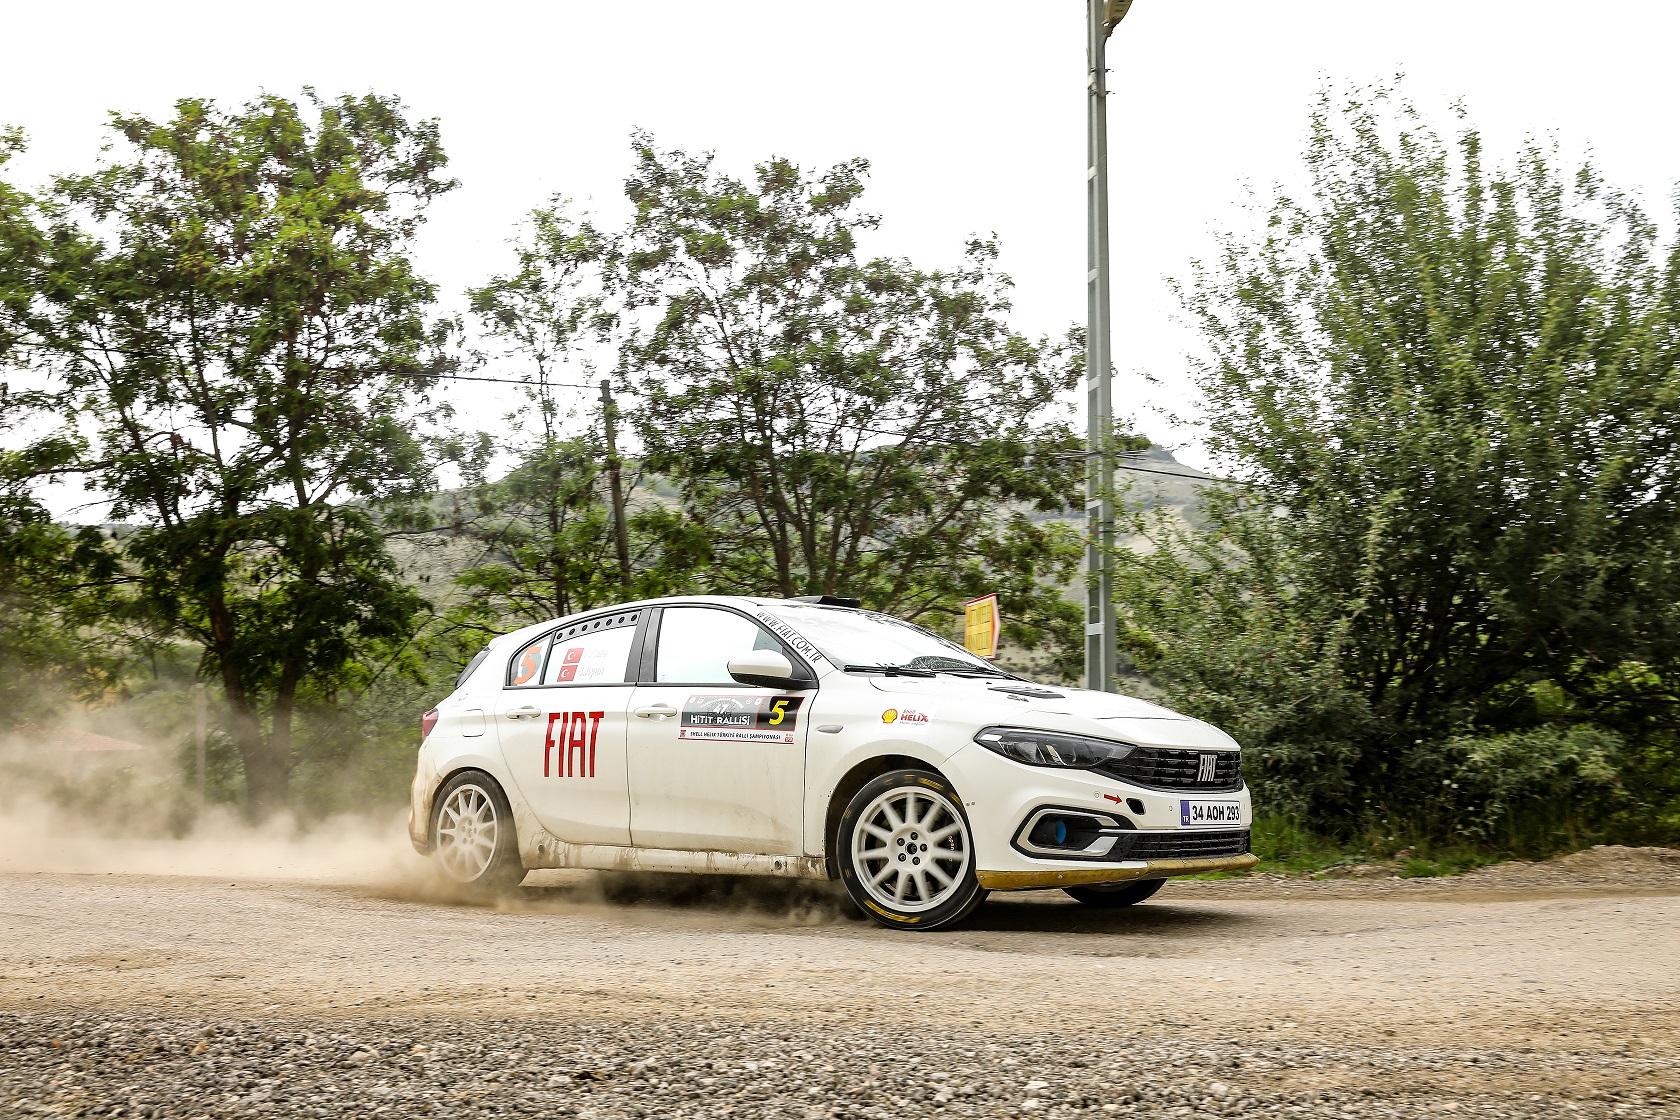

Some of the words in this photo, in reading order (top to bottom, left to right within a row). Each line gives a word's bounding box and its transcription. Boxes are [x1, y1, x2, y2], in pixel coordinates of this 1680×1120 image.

[756, 610, 822, 663] WWW.FIAT.COM.TR
[513, 646, 542, 684] 5
[768, 700, 790, 725] 5
[900, 713, 929, 722] HELIX
[544, 711, 604, 778] FIAT
[1197, 754, 1217, 781] FIAT
[1192, 804, 1204, 820] 34
[1206, 805, 1224, 820] AOH
[1226, 805, 1239, 820] 293
